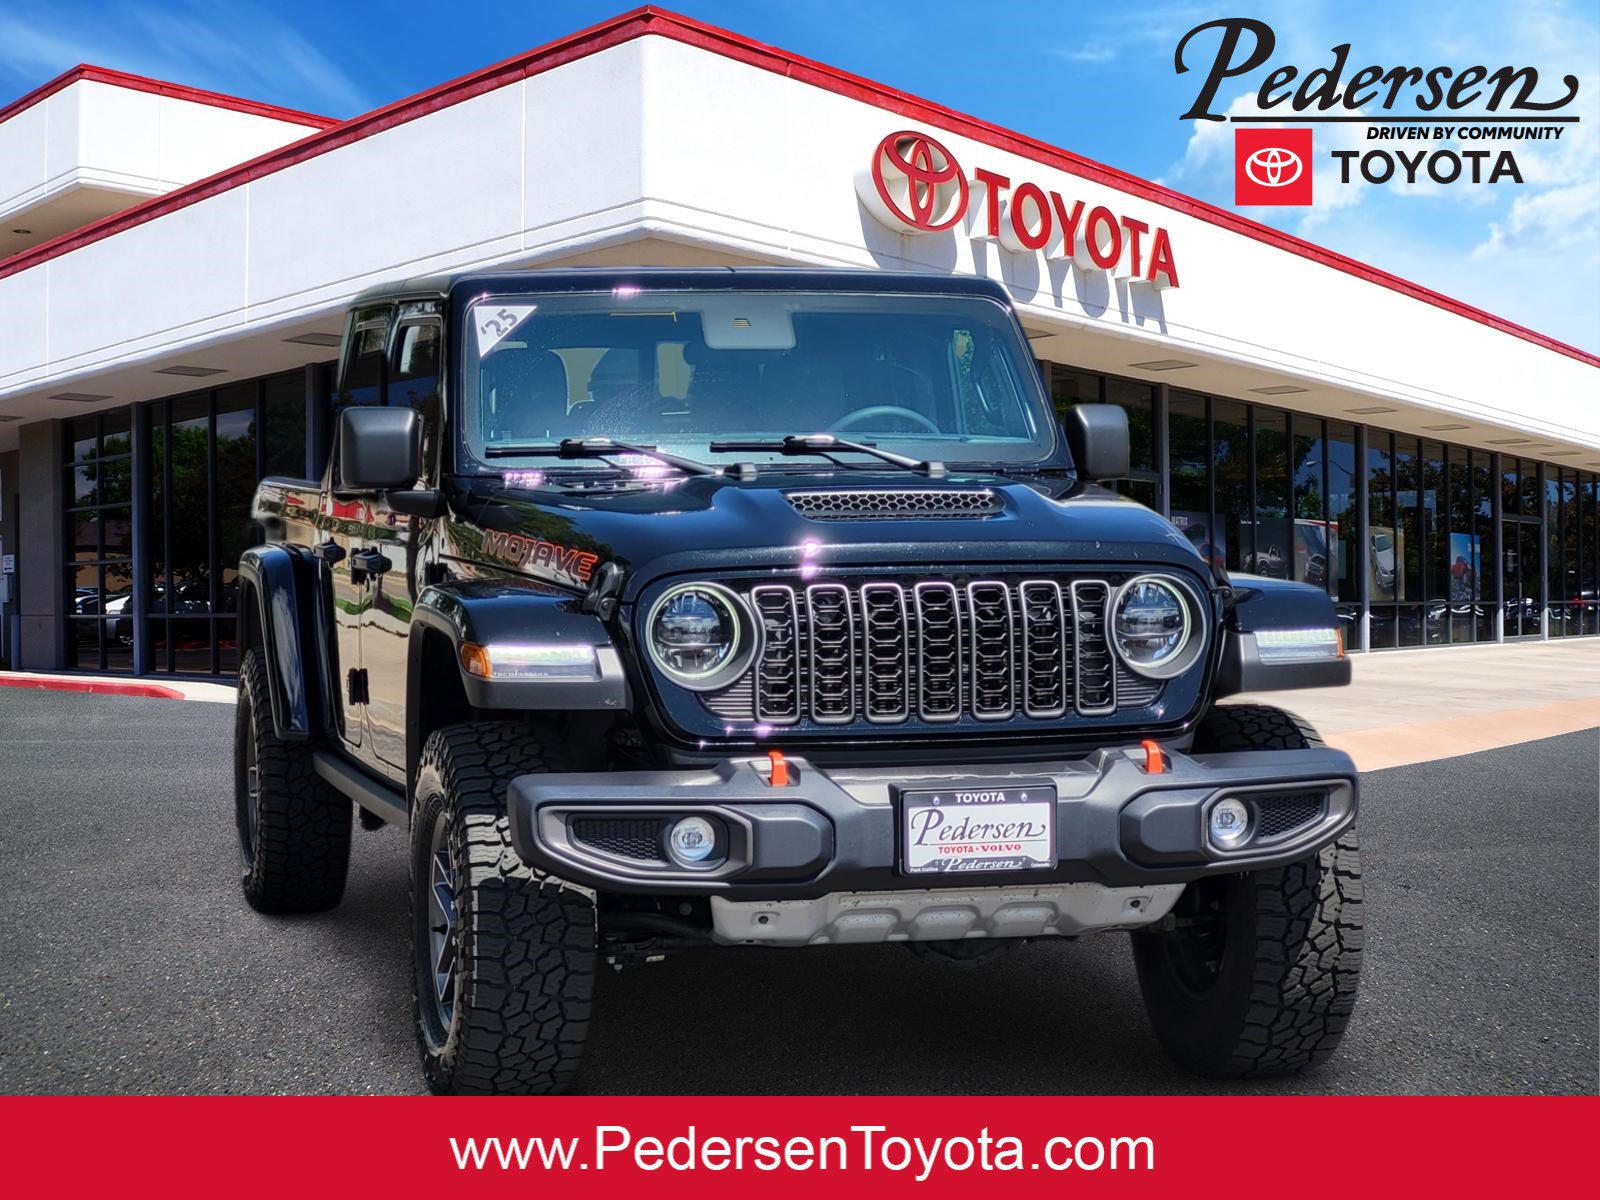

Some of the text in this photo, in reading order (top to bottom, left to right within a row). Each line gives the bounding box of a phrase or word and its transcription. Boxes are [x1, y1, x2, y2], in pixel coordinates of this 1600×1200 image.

[974, 167, 1180, 289] TOYOTA
[481, 308, 518, 337] '25
[480, 528, 599, 582] MOJAVE
[955, 792, 1006, 803] TOYOTA
[911, 808, 1046, 846] Pedersen
[981, 844, 1022, 853] VOLVO
[941, 858, 1022, 871] Pedersen
